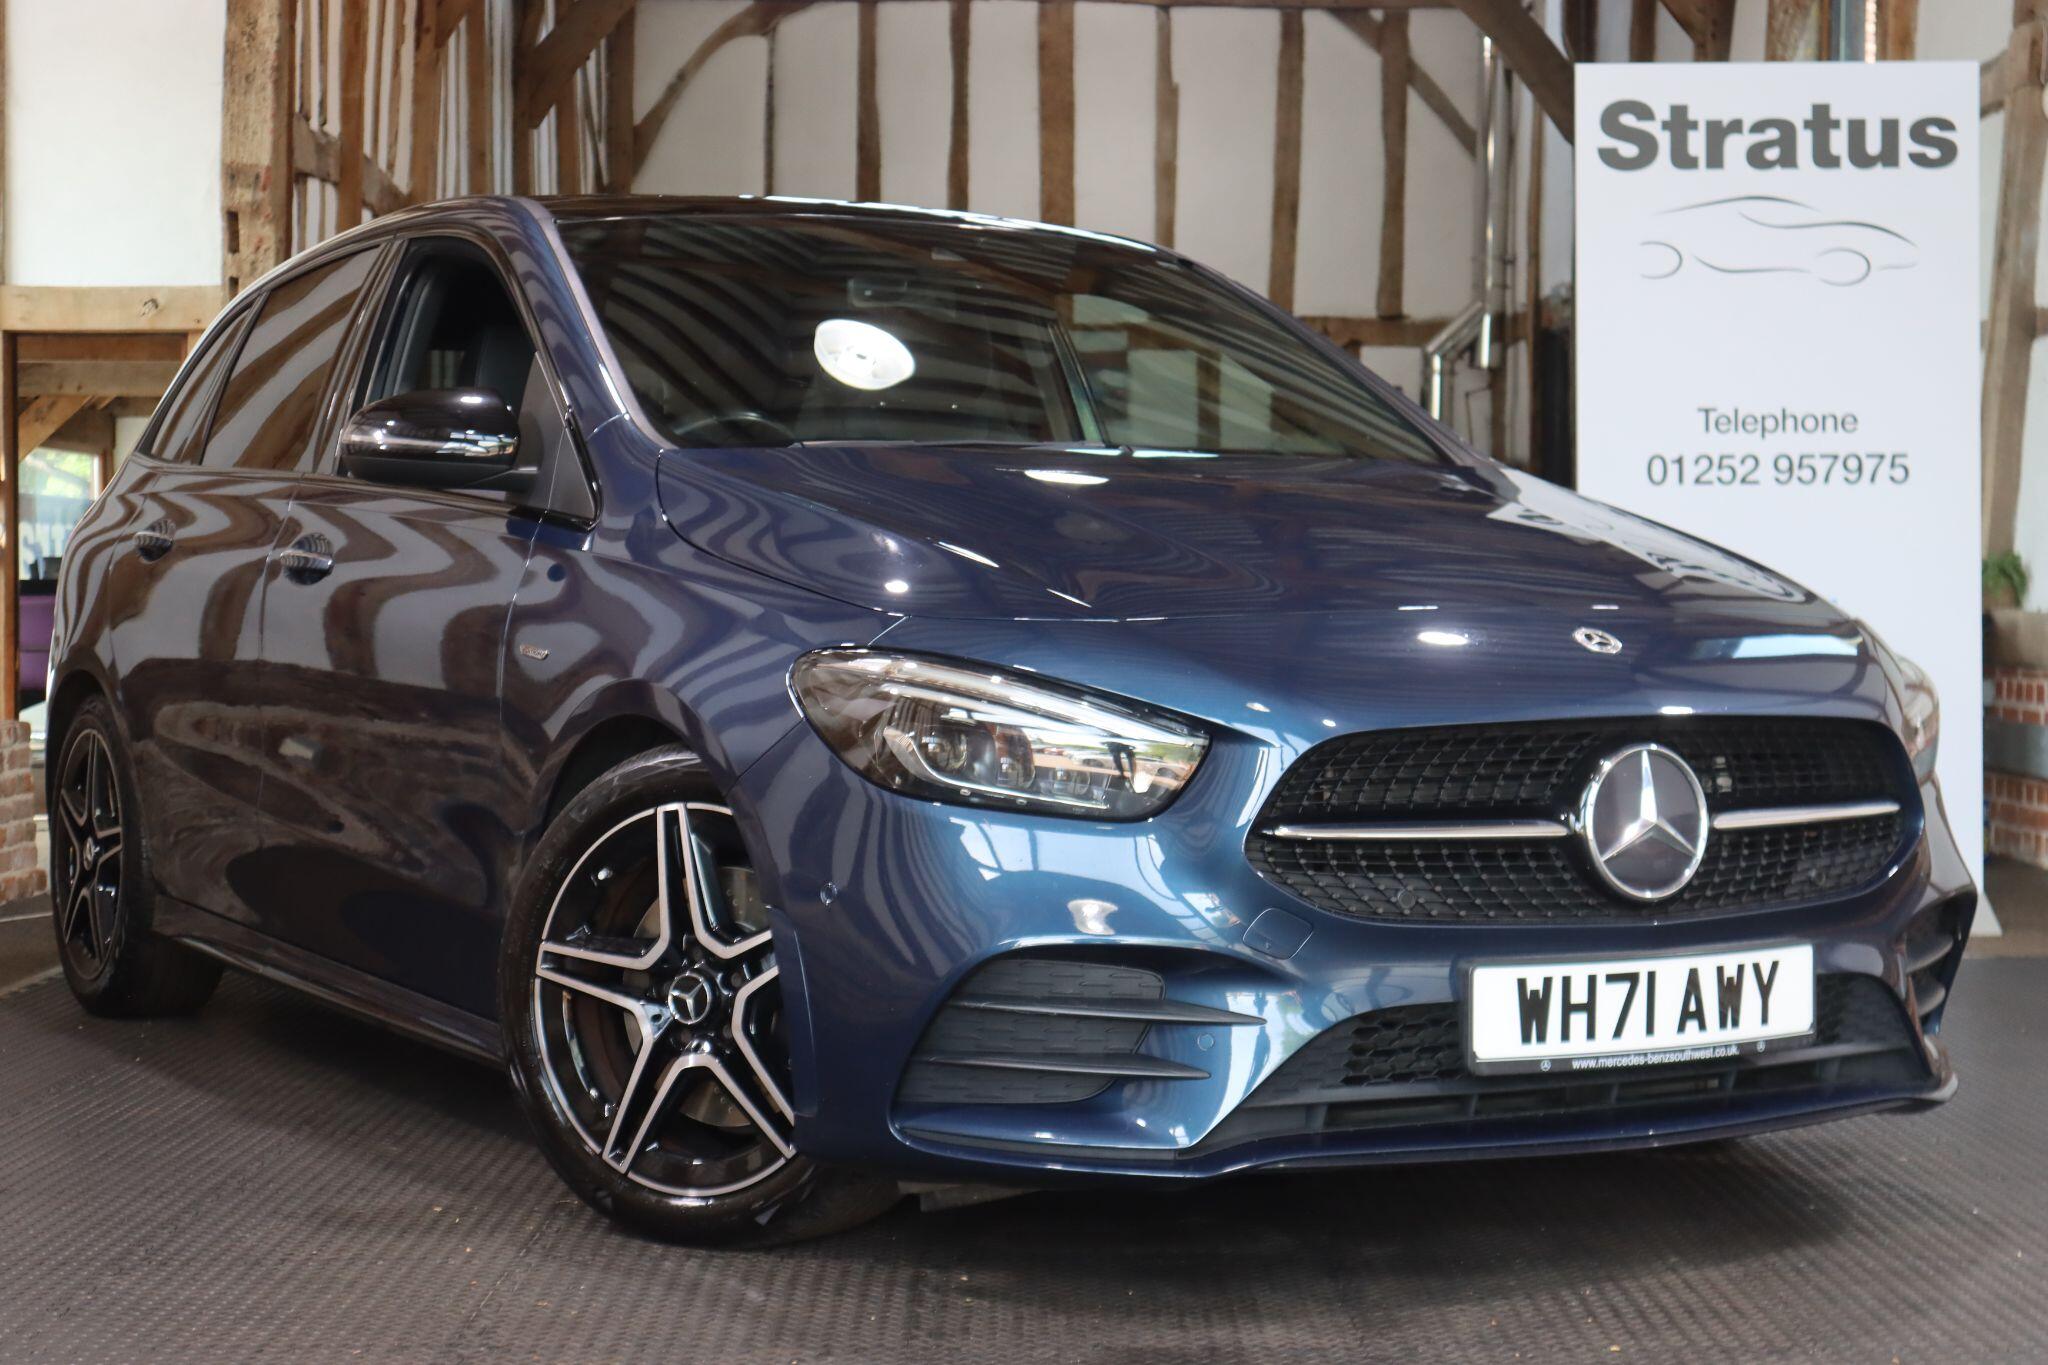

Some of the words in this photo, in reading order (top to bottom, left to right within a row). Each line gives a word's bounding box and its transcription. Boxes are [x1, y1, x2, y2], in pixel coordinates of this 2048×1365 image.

[1597, 99, 1958, 172] Stratus
[1698, 407, 1858, 439] Telephone
[1647, 453, 1760, 486] 01252
[1773, 453, 1910, 485] 957975
[1516, 970, 1656, 1045] WH71
[1676, 960, 1779, 1034] AWY
